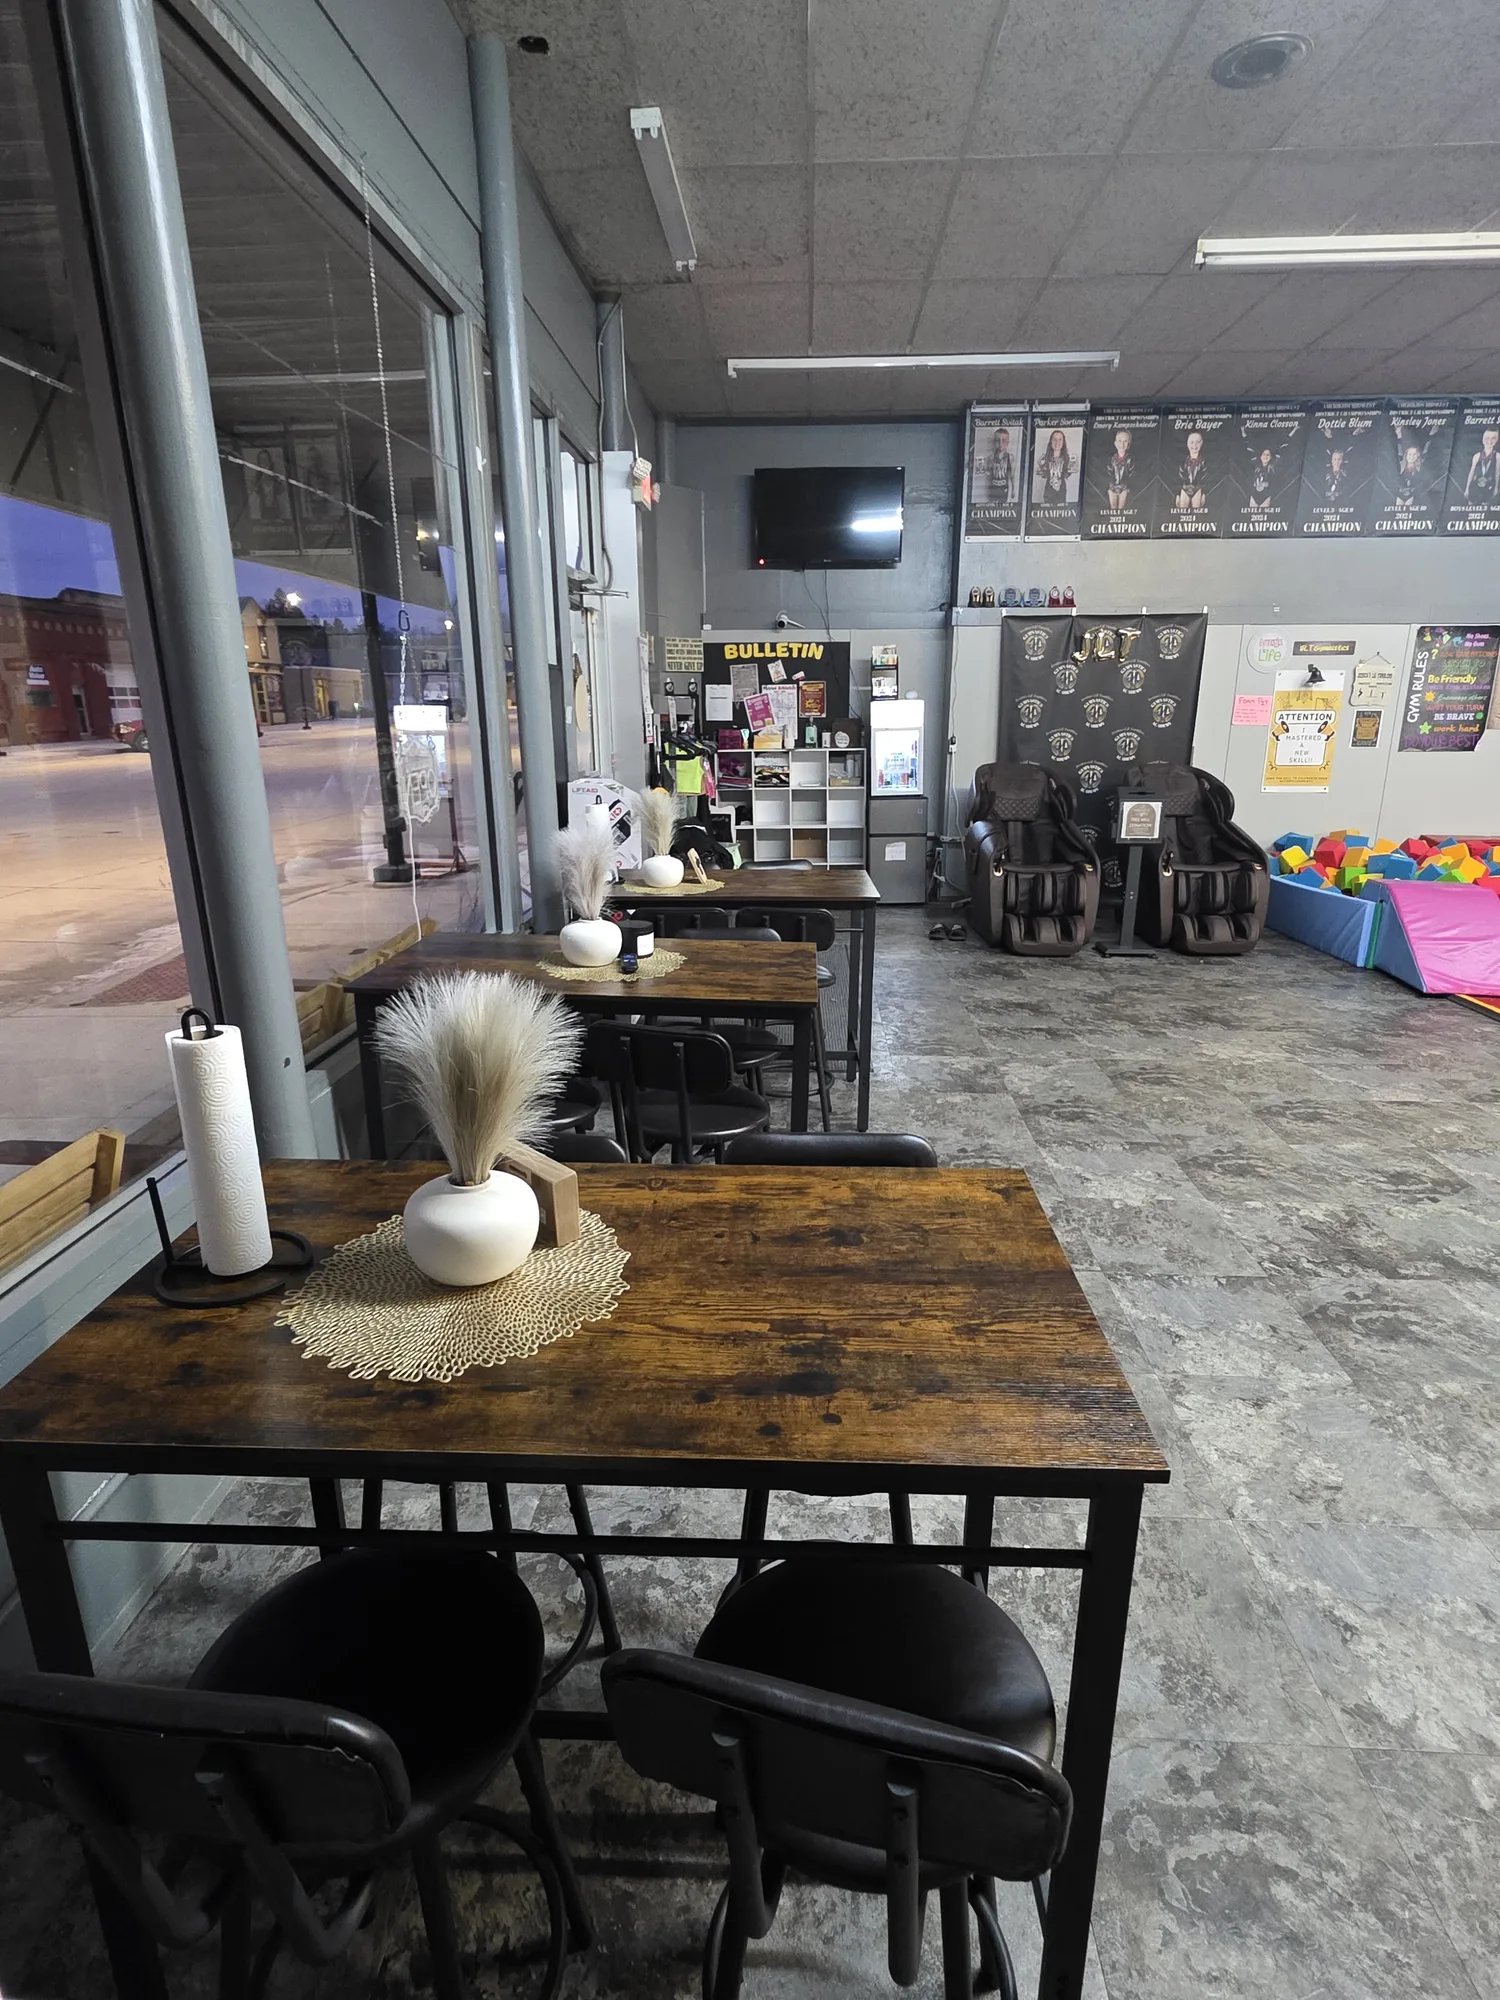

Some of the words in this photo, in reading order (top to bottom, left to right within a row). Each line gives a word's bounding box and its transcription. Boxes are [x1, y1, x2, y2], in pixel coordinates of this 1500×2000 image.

[1174, 419, 1193, 430] Brie
[1195, 419, 1223, 431] Bayer
[1317, 418, 1346, 429] Dottie
[1348, 417, 1373, 428] Blum
[1390, 417, 1421, 428] Kinsley
[1422, 416, 1447, 428] Jones
[1464, 415, 1495, 425] Barrett
[970, 509, 1017, 518] CHAMPION
[1030, 509, 1077, 518] CHAMPION
[1090, 524, 1148, 534] CHAMPION
[1160, 522, 1218, 532] CHAMPION
[1231, 522, 1289, 532] CHAMPION
[1303, 522, 1362, 532] CHAMPION
[1374, 520, 1434, 531] CHAMPION
[1446, 520, 1500, 531] CHAMPIO
[1071, 627, 1141, 662] JLT
[724, 642, 824, 660] BULLETIN
[1258, 649, 1282, 662] Life
[1412, 651, 1430, 691] RULES
[1428, 674, 1440, 684] Be
[1440, 674, 1477, 685] Friendly
[1406, 694, 1422, 722] GYM
[1446, 712, 1475, 720] BRAVE
[1433, 724, 1456, 732] work
[1458, 724, 1480, 732] hard
